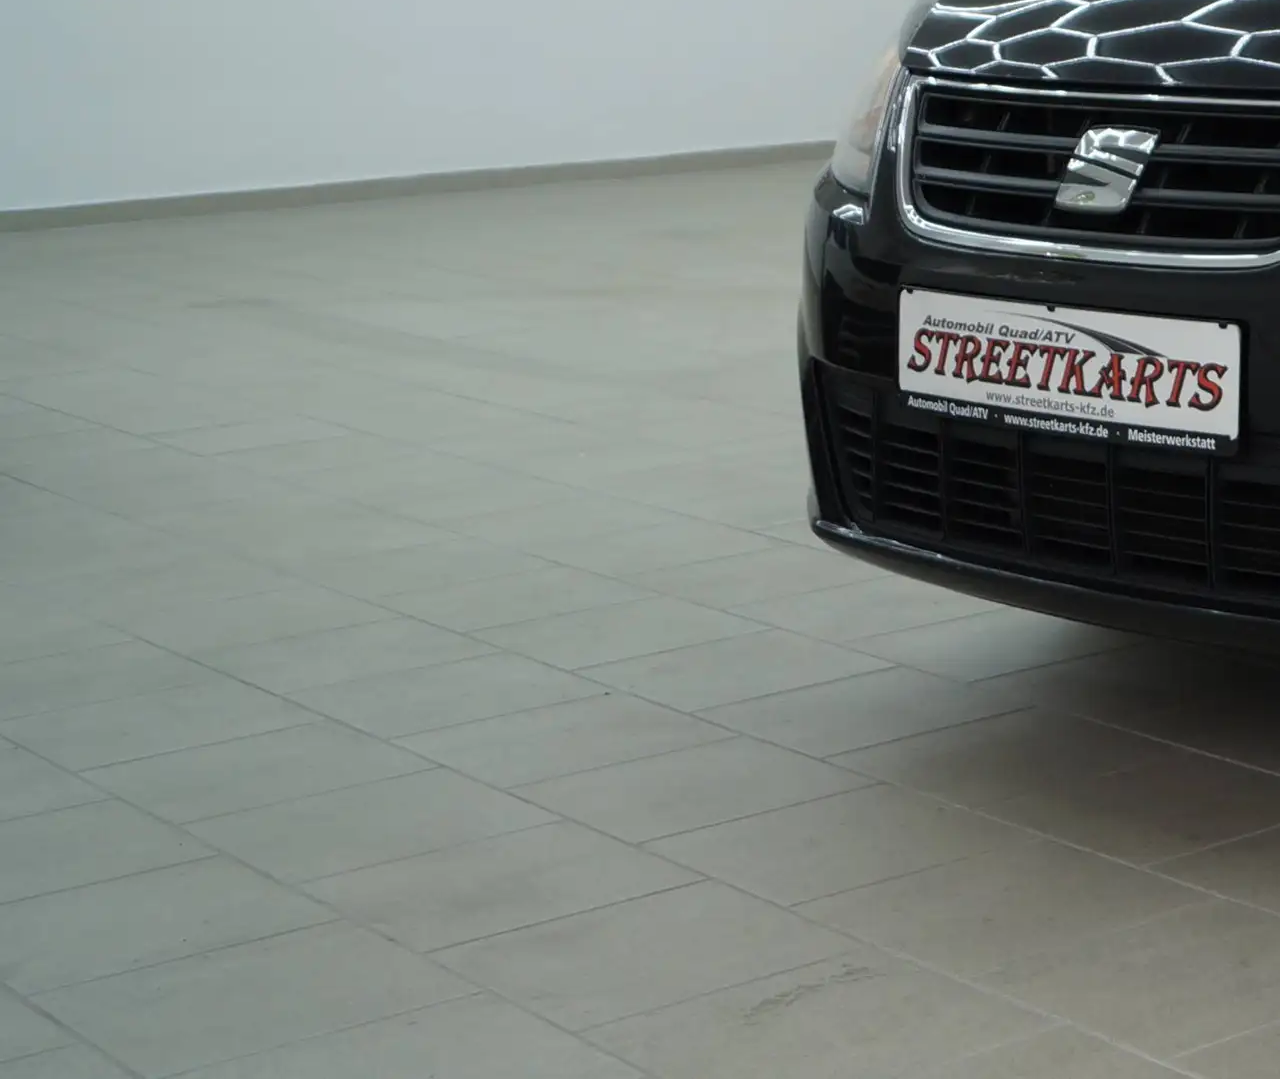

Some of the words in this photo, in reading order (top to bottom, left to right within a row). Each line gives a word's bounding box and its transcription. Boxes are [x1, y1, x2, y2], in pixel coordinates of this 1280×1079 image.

[923, 315, 994, 336] Automobil
[998, 323, 1076, 345] Quad/ATV
[907, 328, 1228, 411] STREETKARTS
[907, 395, 949, 414] Automobil
[949, 403, 989, 421] Quad/ATV
[1004, 412, 1109, 438] www.streetkarts-kfz.de
[1128, 429, 1216, 450] Meisterwerkstatt
[986, 390, 1115, 418] www.streetkarts-kfz.de
